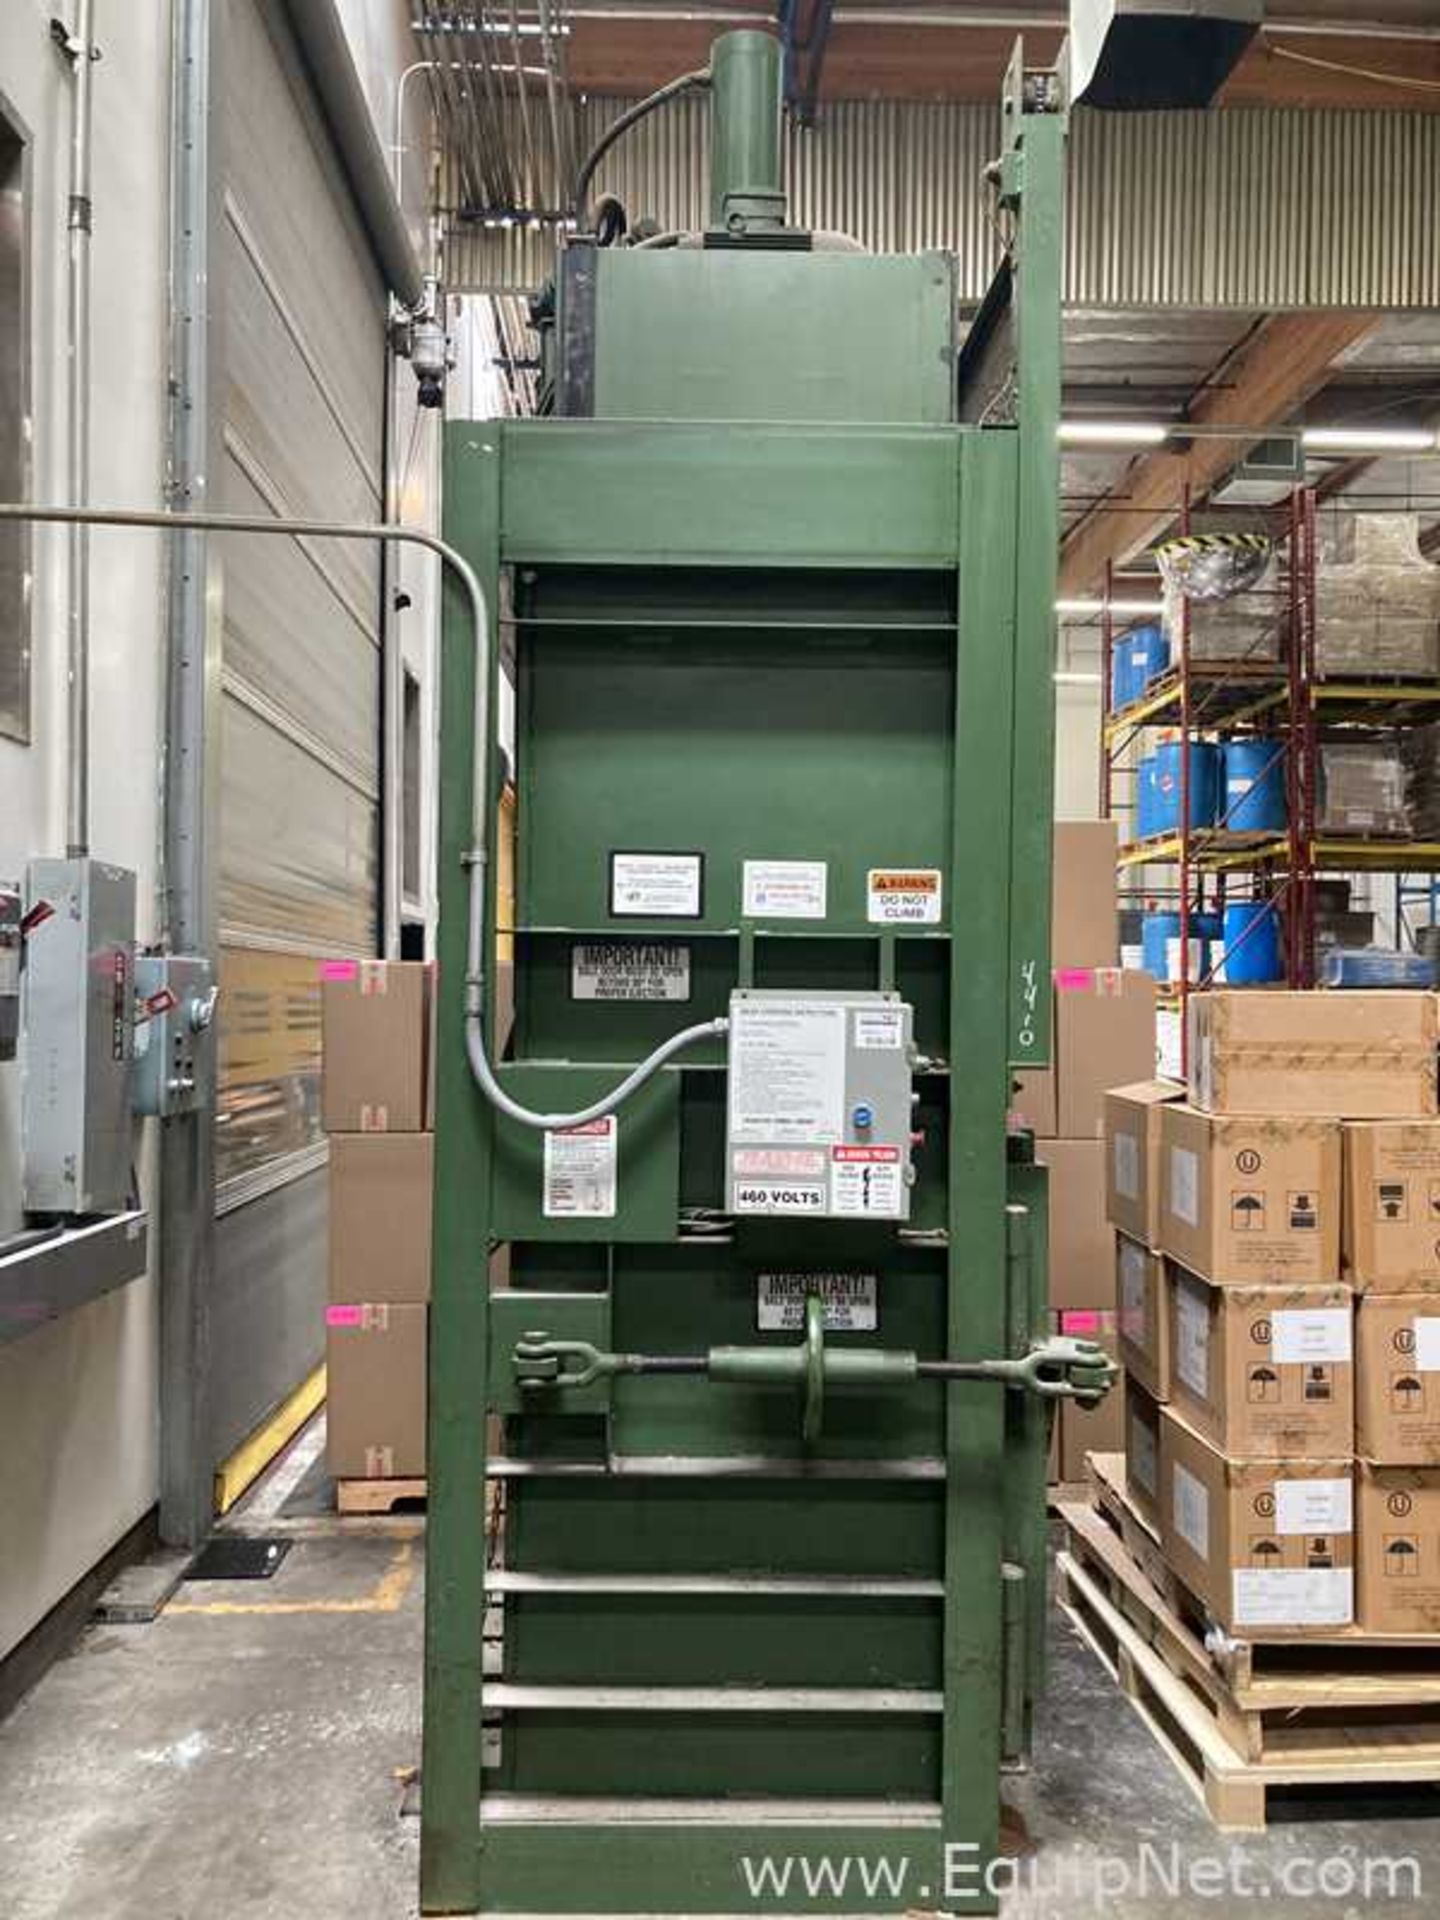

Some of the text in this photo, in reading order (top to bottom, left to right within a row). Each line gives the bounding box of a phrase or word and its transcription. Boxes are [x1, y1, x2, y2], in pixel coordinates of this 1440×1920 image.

[880, 895, 927, 905] DO NOT
[884, 907, 925, 918] CLIMB
[583, 945, 679, 965] IMPORTANT!
[740, 1189, 820, 1205] 460 VOLTS
